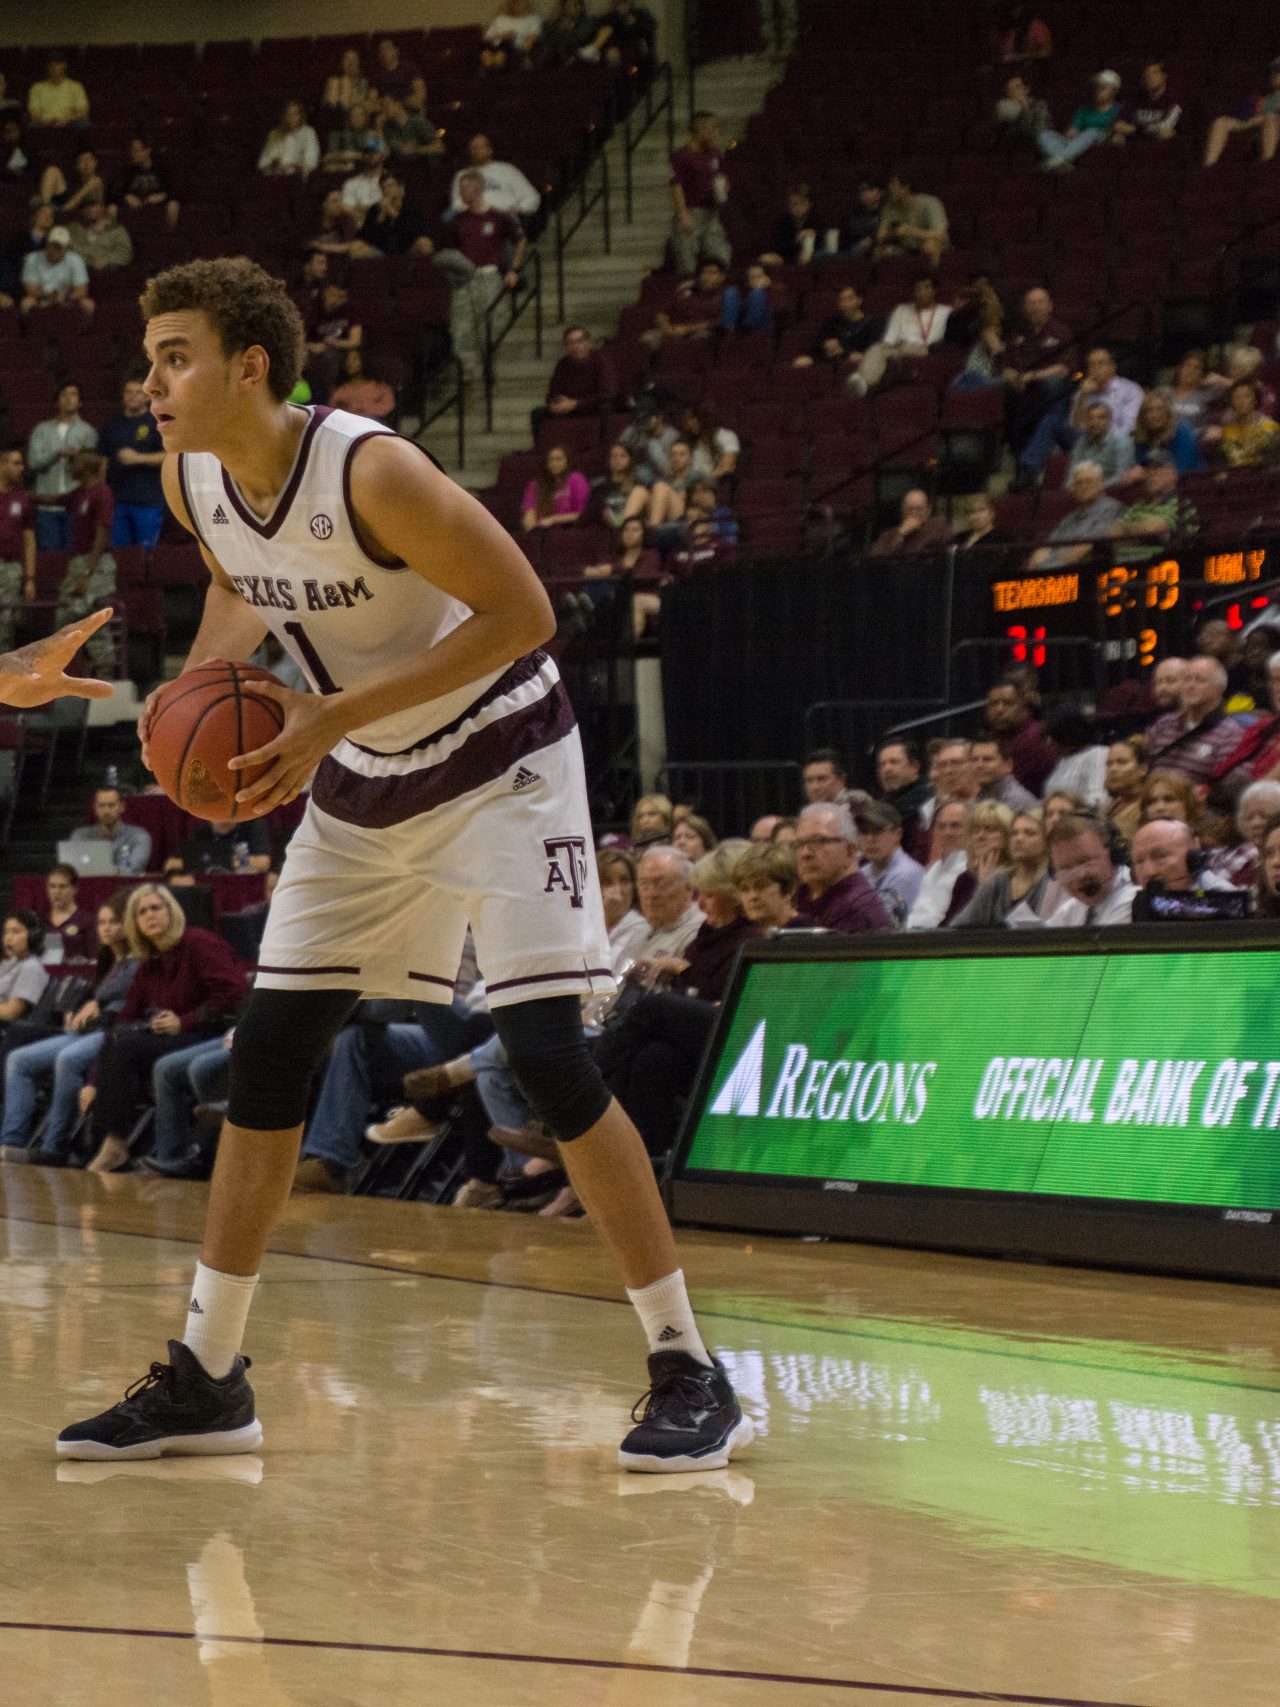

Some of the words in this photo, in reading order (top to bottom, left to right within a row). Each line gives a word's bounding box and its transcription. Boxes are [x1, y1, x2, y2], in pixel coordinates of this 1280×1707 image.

[231, 575, 298, 611] EXAS
[303, 576, 375, 611] A&M
[284, 621, 344, 696] 1
[512, 774, 541, 791] adidas
[765, 1044, 937, 1124] REGIONS
[972, 1057, 1105, 1123] OFFICIAL
[1105, 1059, 1205, 1127] BANK
[1201, 1059, 1262, 1129] OF
